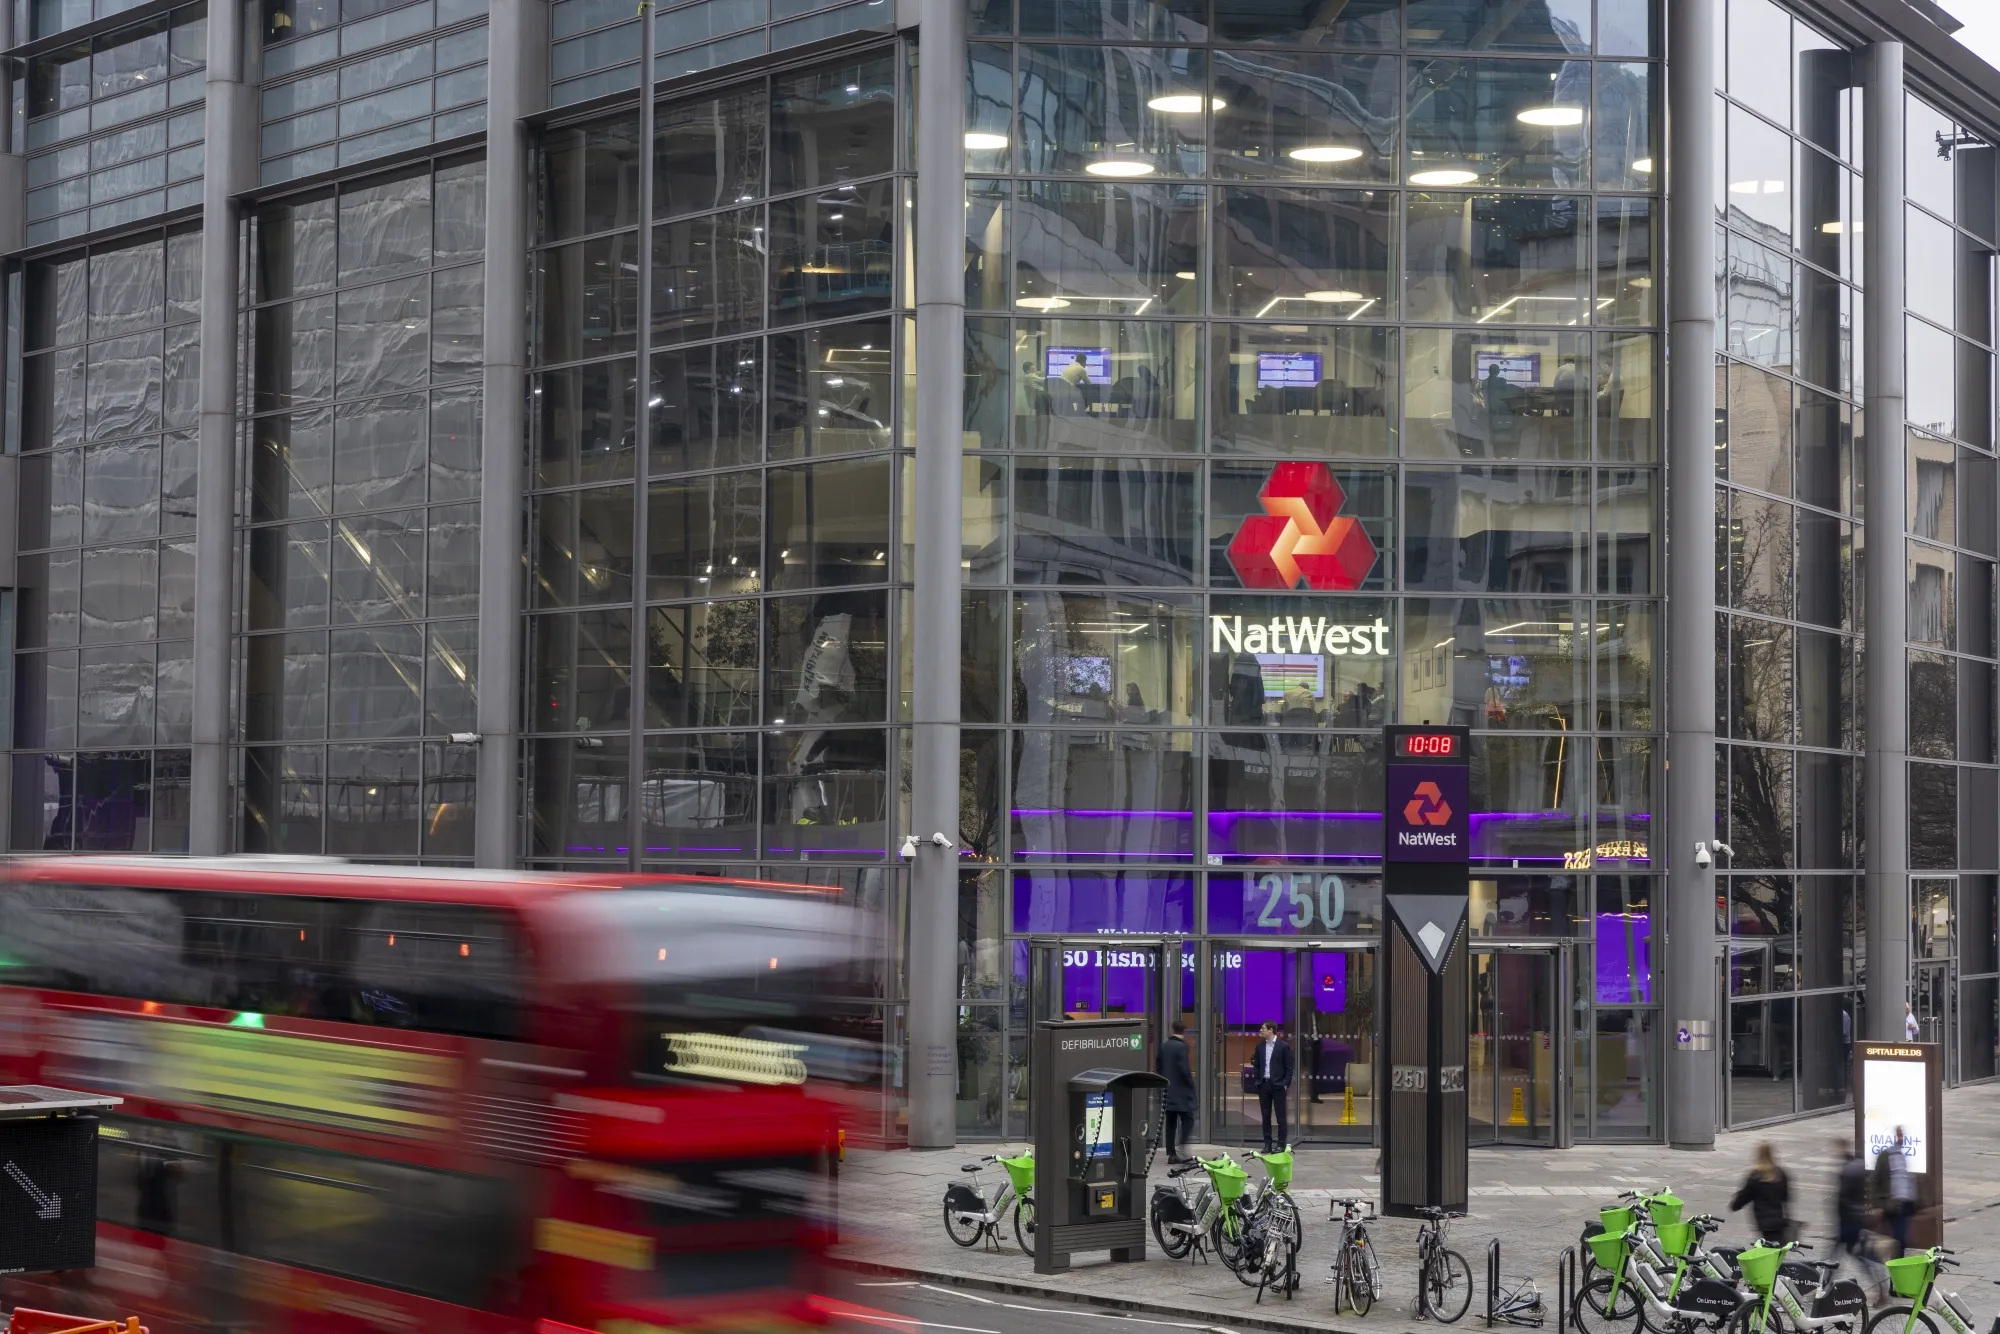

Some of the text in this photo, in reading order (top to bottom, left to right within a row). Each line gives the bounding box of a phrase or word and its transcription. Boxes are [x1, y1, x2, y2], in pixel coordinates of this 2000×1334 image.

[1212, 615, 1390, 656] NatWest
[1408, 736, 1452, 753] 10:08
[1398, 832, 1457, 846] NatWest
[1257, 873, 1345, 929] 250
[1060, 951, 1088, 968] 50
[1061, 1037, 1129, 1050] DEFIBRILLATOR
[1866, 1047, 1922, 1057] SPITALFIELDS
[1393, 1068, 1426, 1089] 250
[1201, 1205, 1217, 1226] Lime
[1783, 1292, 1802, 1318] Lime
[1940, 1304, 1966, 1334] Lime
